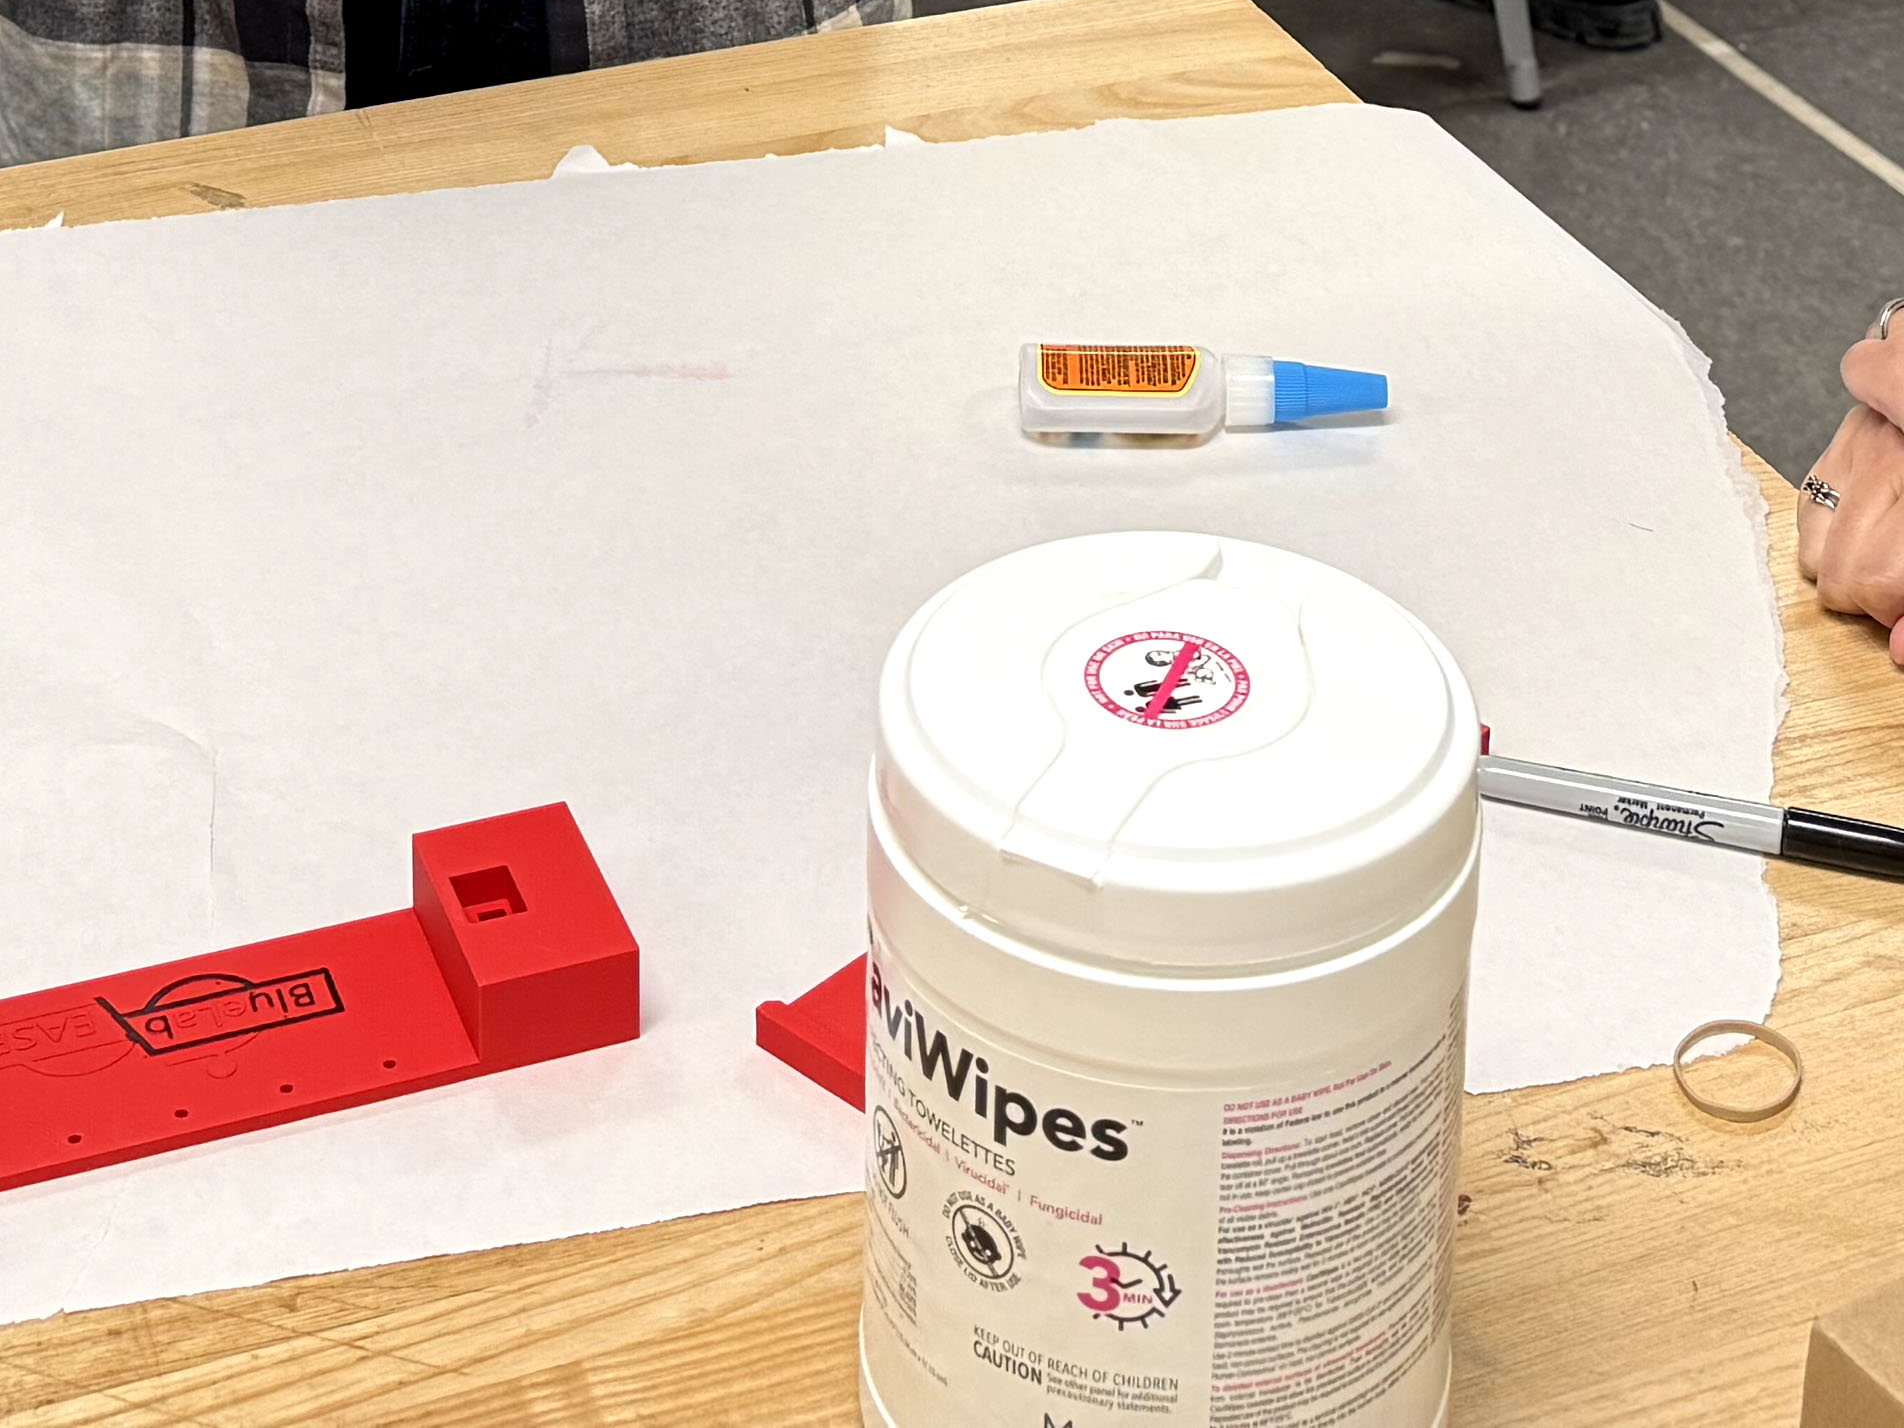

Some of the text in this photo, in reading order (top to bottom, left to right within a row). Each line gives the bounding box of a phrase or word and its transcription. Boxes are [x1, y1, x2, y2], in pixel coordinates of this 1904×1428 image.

[1617, 796, 1705, 819] Permanent Marker
[144, 981, 316, 1040] BlueLab
[870, 950, 1129, 1163] aviWipes
[908, 1088, 1016, 1177] TOWELETTES
[1029, 1195, 1104, 1227] Fungicidal
[1077, 1255, 1121, 1313] 3
[1122, 1292, 1154, 1305] MIN
[973, 1324, 1179, 1391] KEEP OUT OF REACH OF CHILDREN
[973, 1340, 1043, 1387] CAUTION
